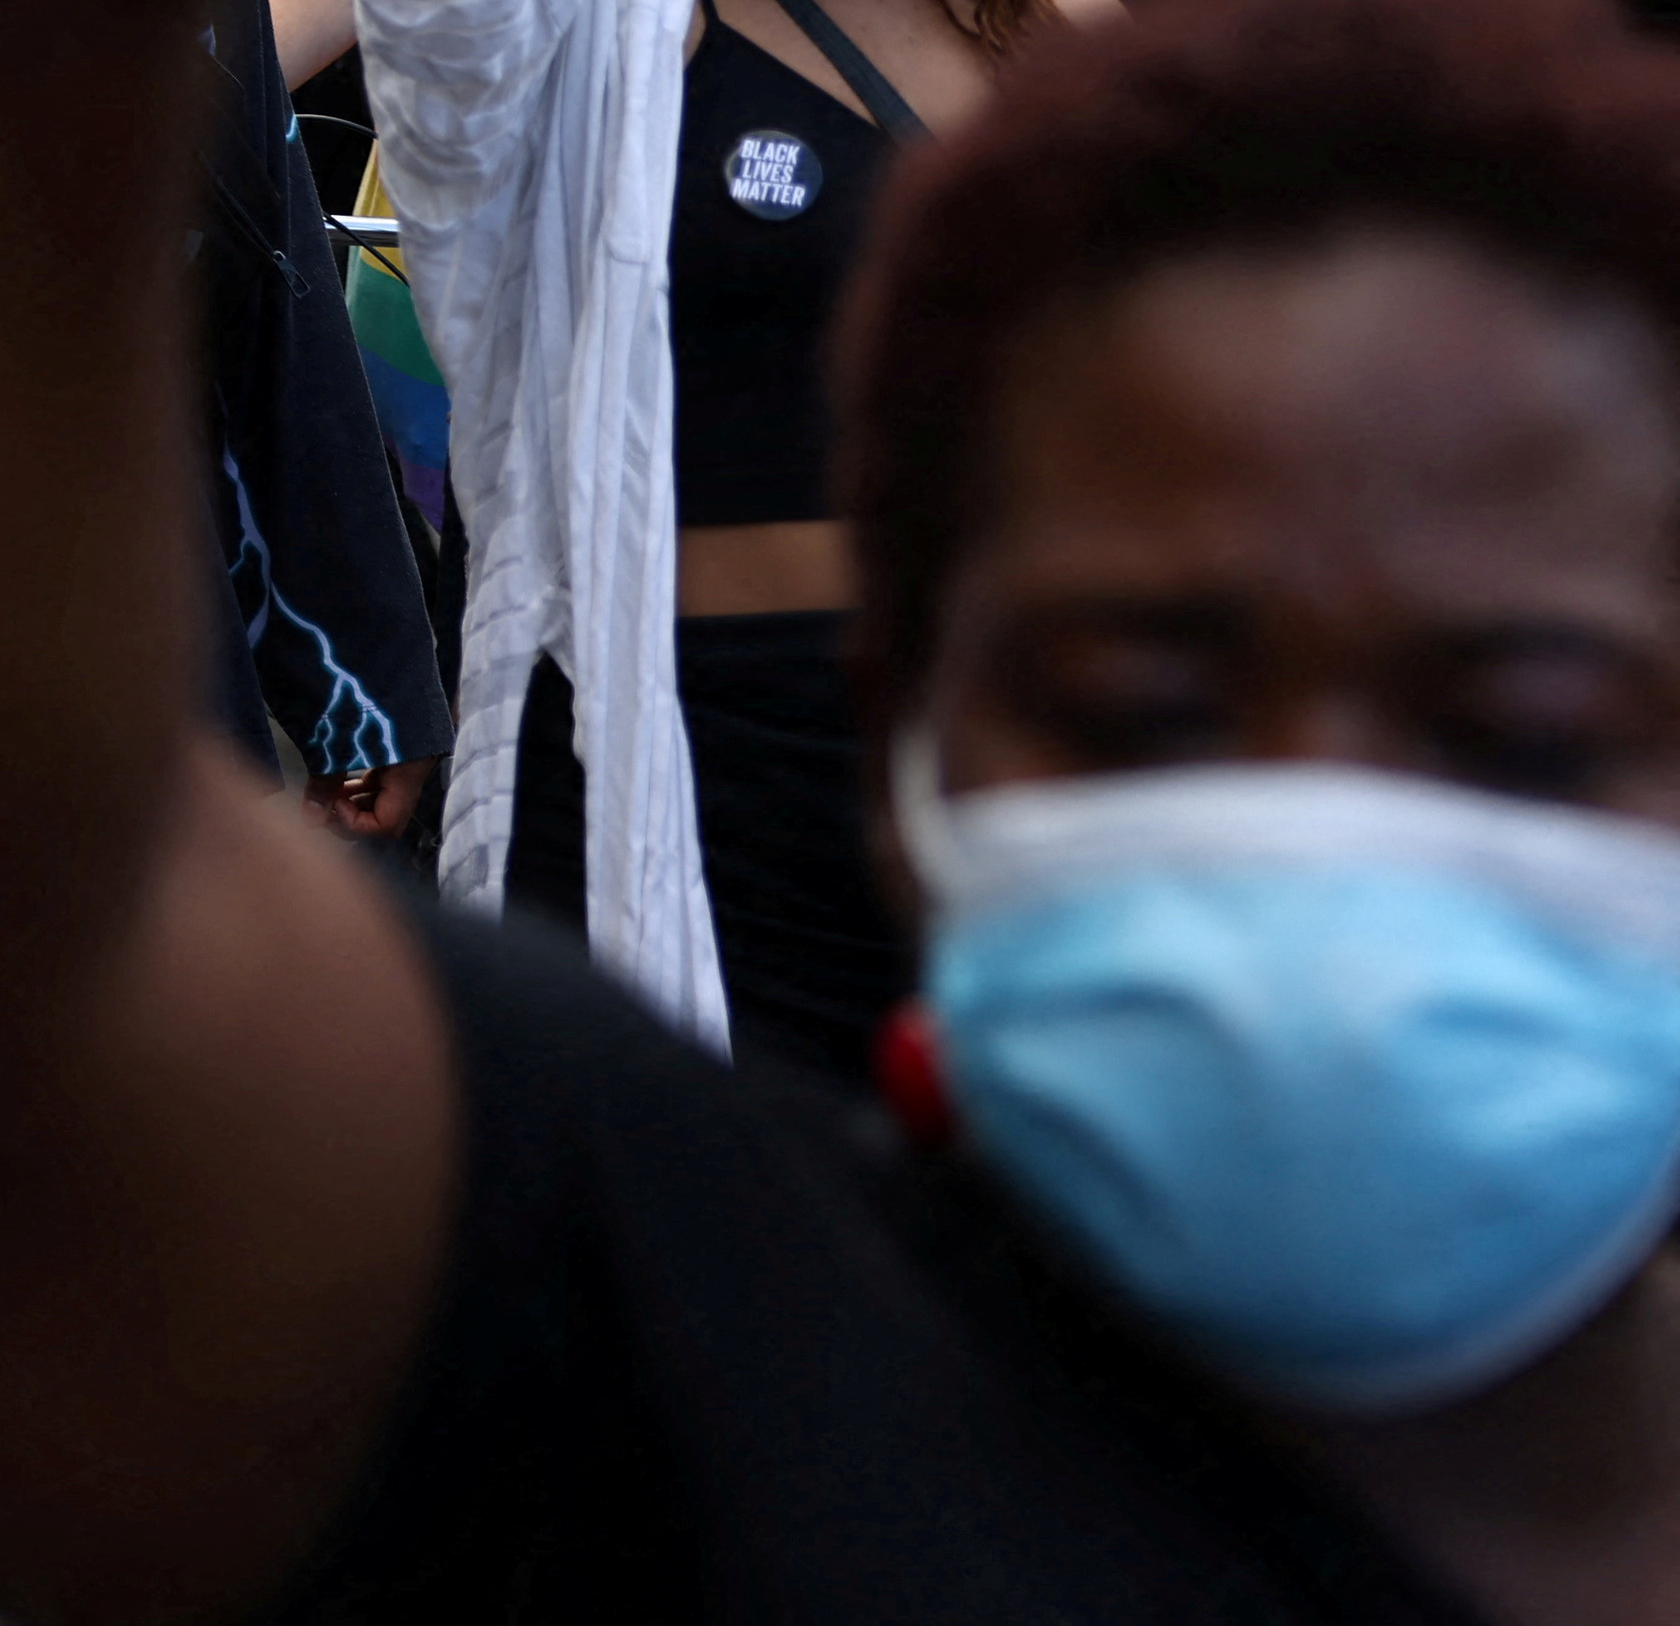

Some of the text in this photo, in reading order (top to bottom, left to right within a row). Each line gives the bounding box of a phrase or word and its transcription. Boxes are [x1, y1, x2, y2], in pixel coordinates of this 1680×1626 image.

[741, 139, 801, 167] BLACK
[742, 159, 795, 185] LIVES
[732, 178, 806, 207] MATTER
